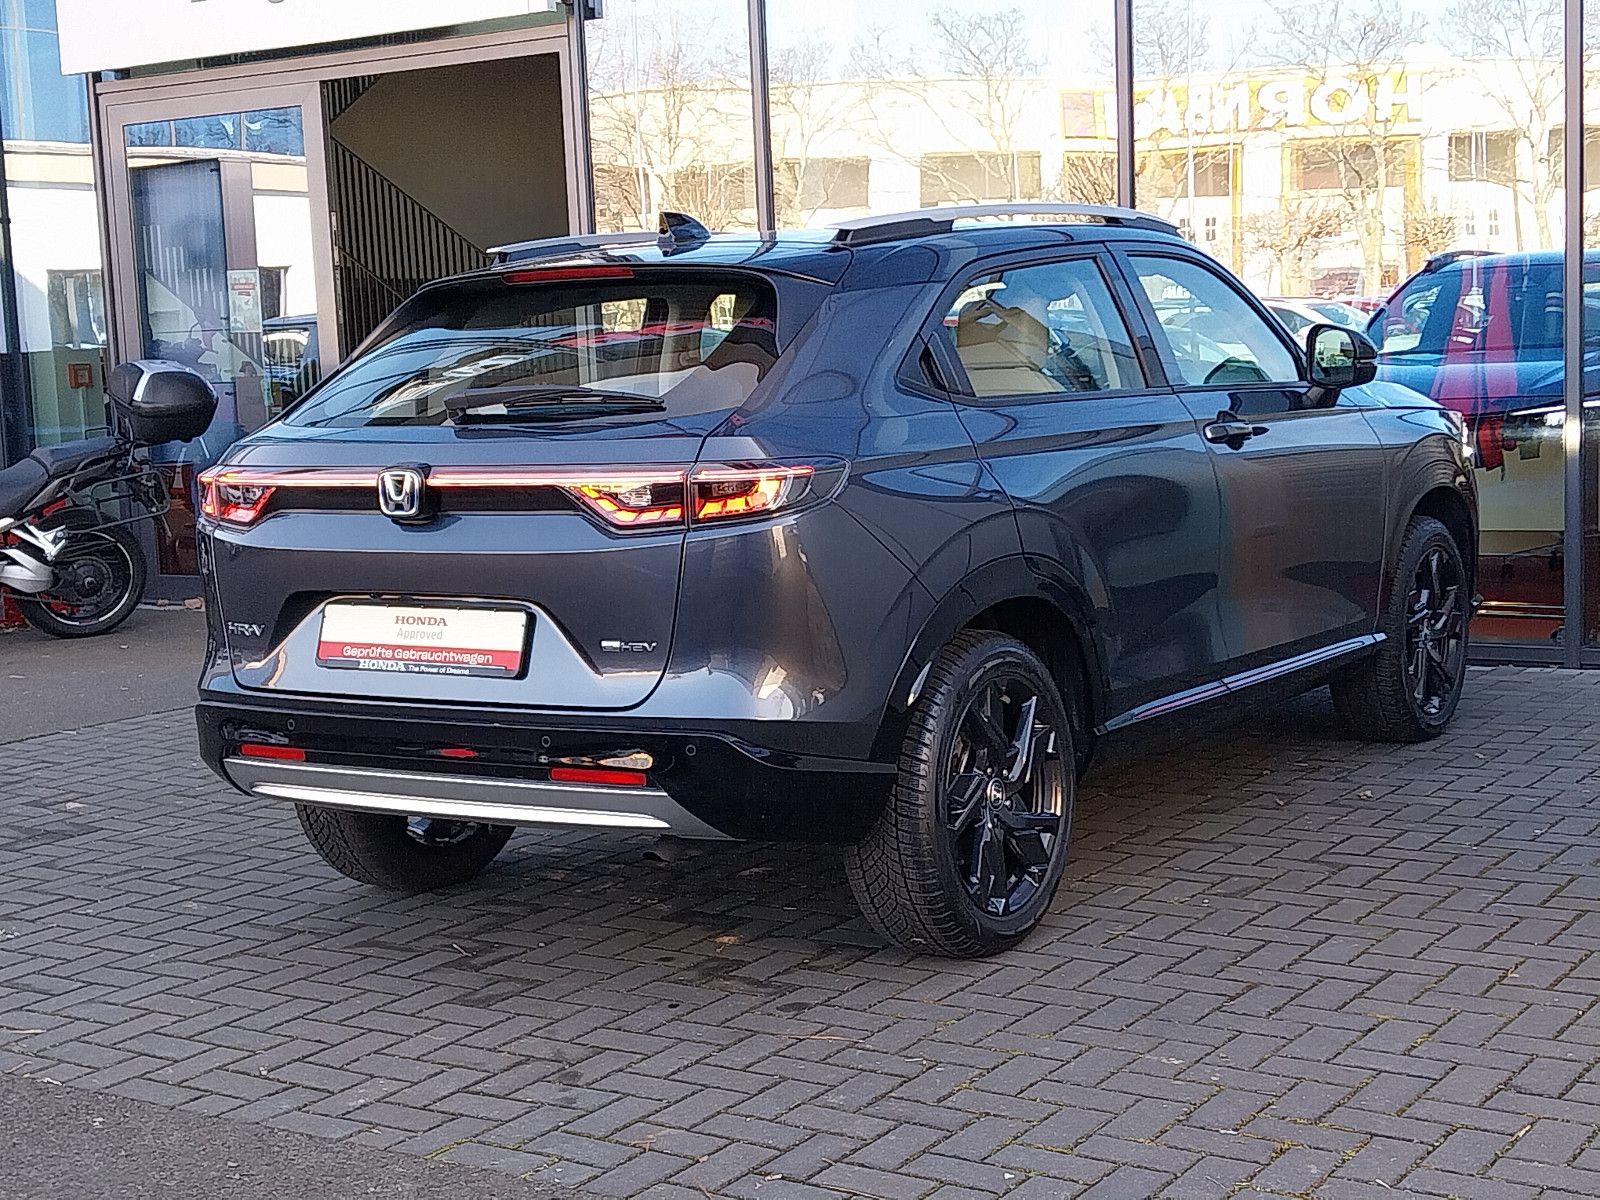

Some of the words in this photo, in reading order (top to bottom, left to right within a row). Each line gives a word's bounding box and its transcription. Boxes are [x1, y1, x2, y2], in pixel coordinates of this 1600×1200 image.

[394, 615, 449, 627] HONDA
[396, 627, 443, 641] Approved
[342, 645, 393, 659] Geprüfte
[394, 648, 493, 664] Gebrauchtwagen
[358, 659, 407, 672] HONDA
[408, 664, 420, 672] The
[439, 666, 446, 674] of
